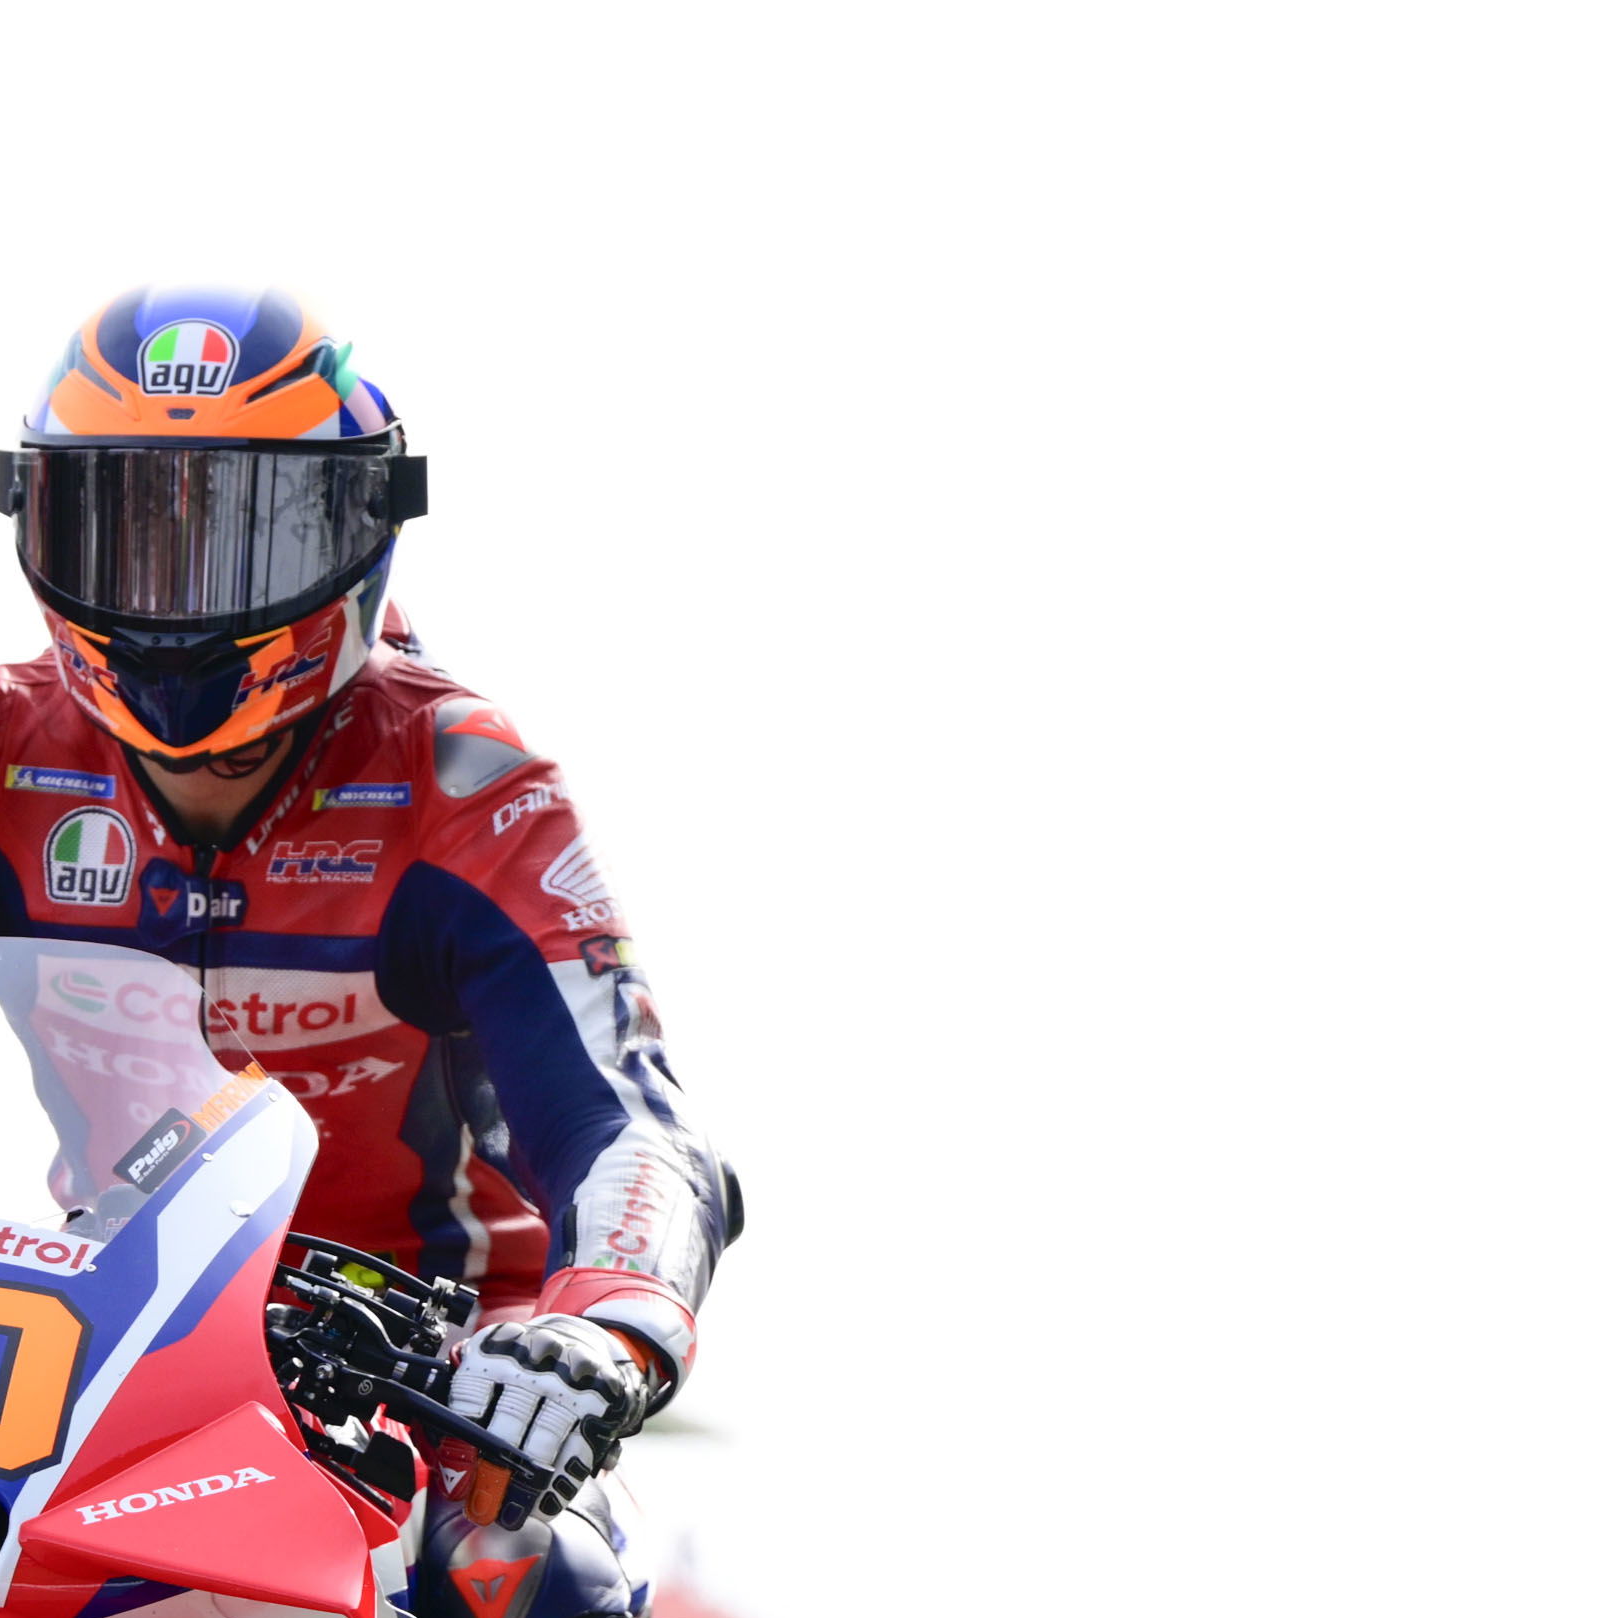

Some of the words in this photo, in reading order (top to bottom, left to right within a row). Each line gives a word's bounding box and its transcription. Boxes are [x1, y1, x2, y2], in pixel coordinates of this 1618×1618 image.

[150, 364, 221, 394] agv
[266, 839, 383, 876] HRC
[56, 866, 121, 902] agv
[115, 982, 357, 1036] Castrol
[127, 1129, 180, 1181] Puig
[75, 1466, 276, 1526] HONDA
